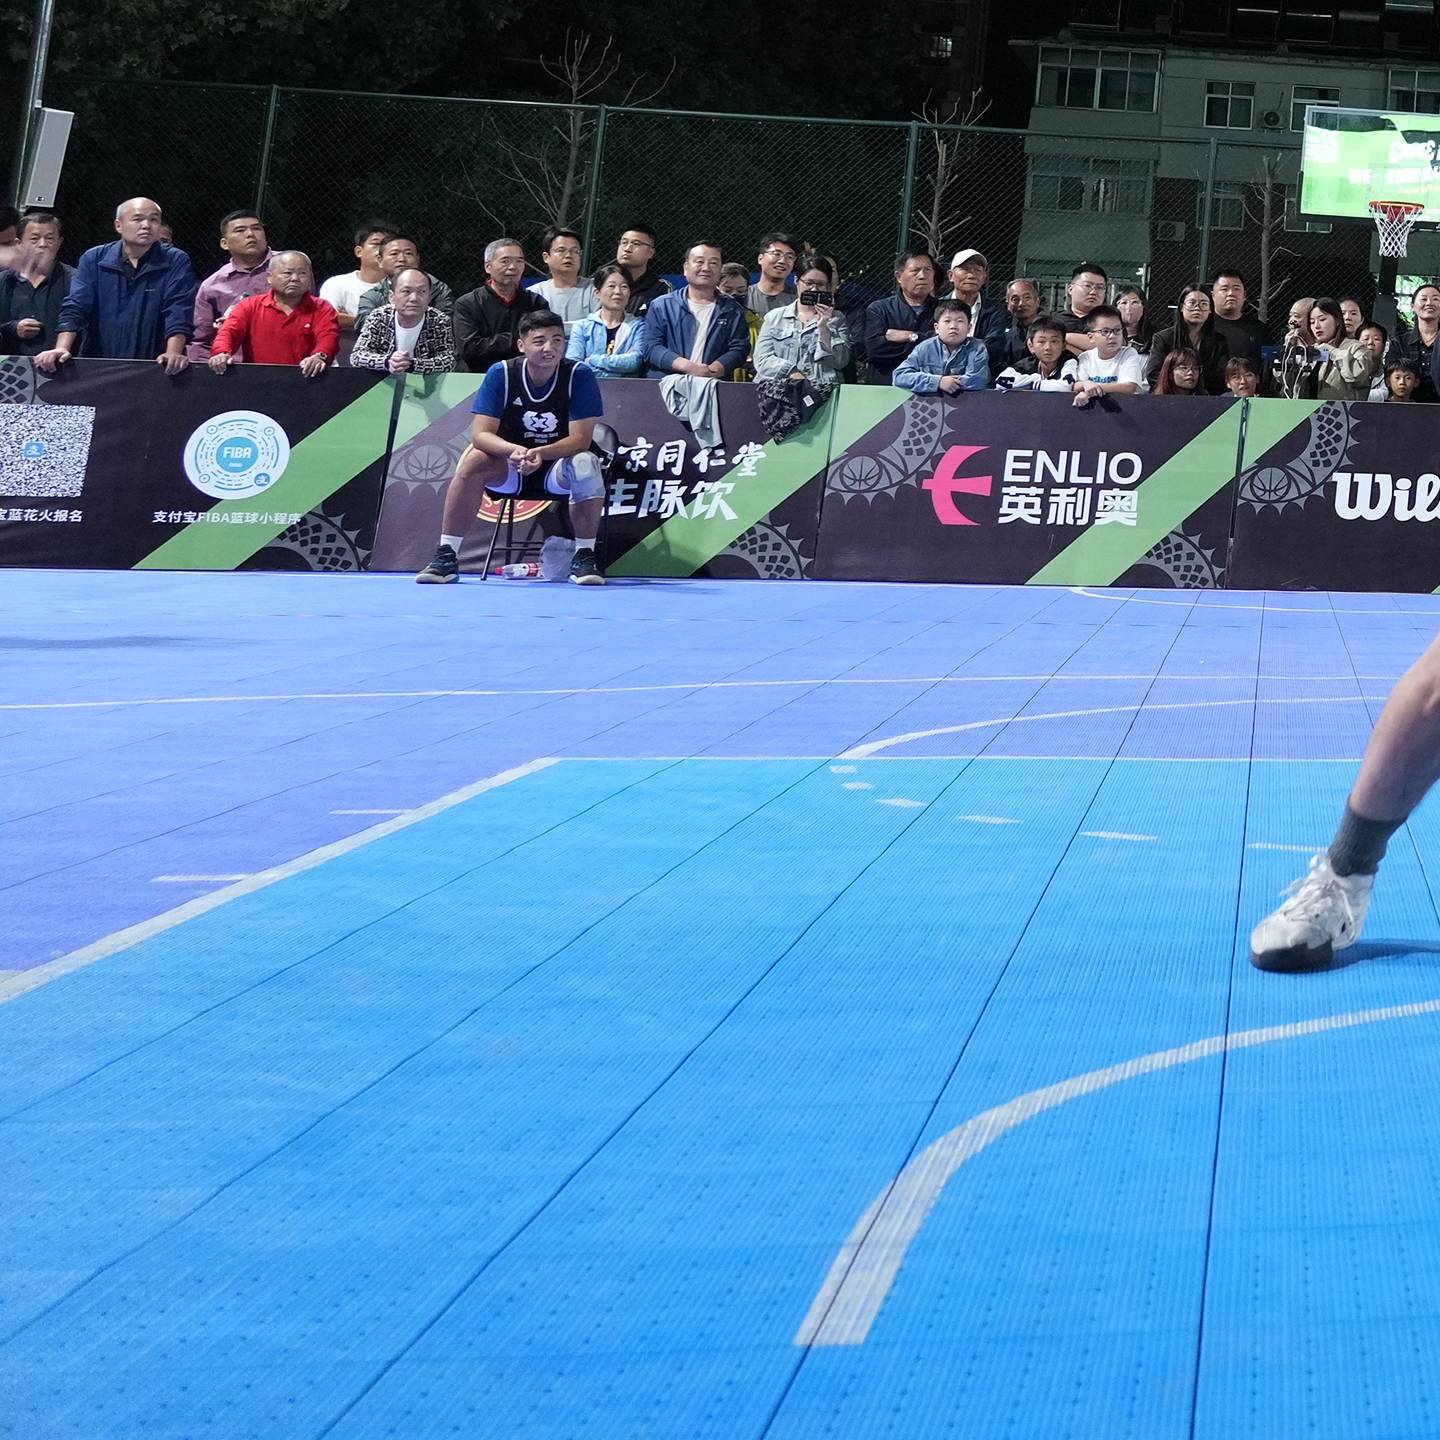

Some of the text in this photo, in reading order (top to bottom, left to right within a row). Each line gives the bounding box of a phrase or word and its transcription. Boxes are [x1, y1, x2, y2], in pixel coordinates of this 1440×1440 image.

[223, 446, 252, 459] FIBA
[600, 437, 767, 476] 京同仁堂
[1003, 449, 1143, 485] ENLIO
[152, 510, 302, 525] 支付宝FIBA篮球小程序
[998, 486, 1138, 527] 英利奥
